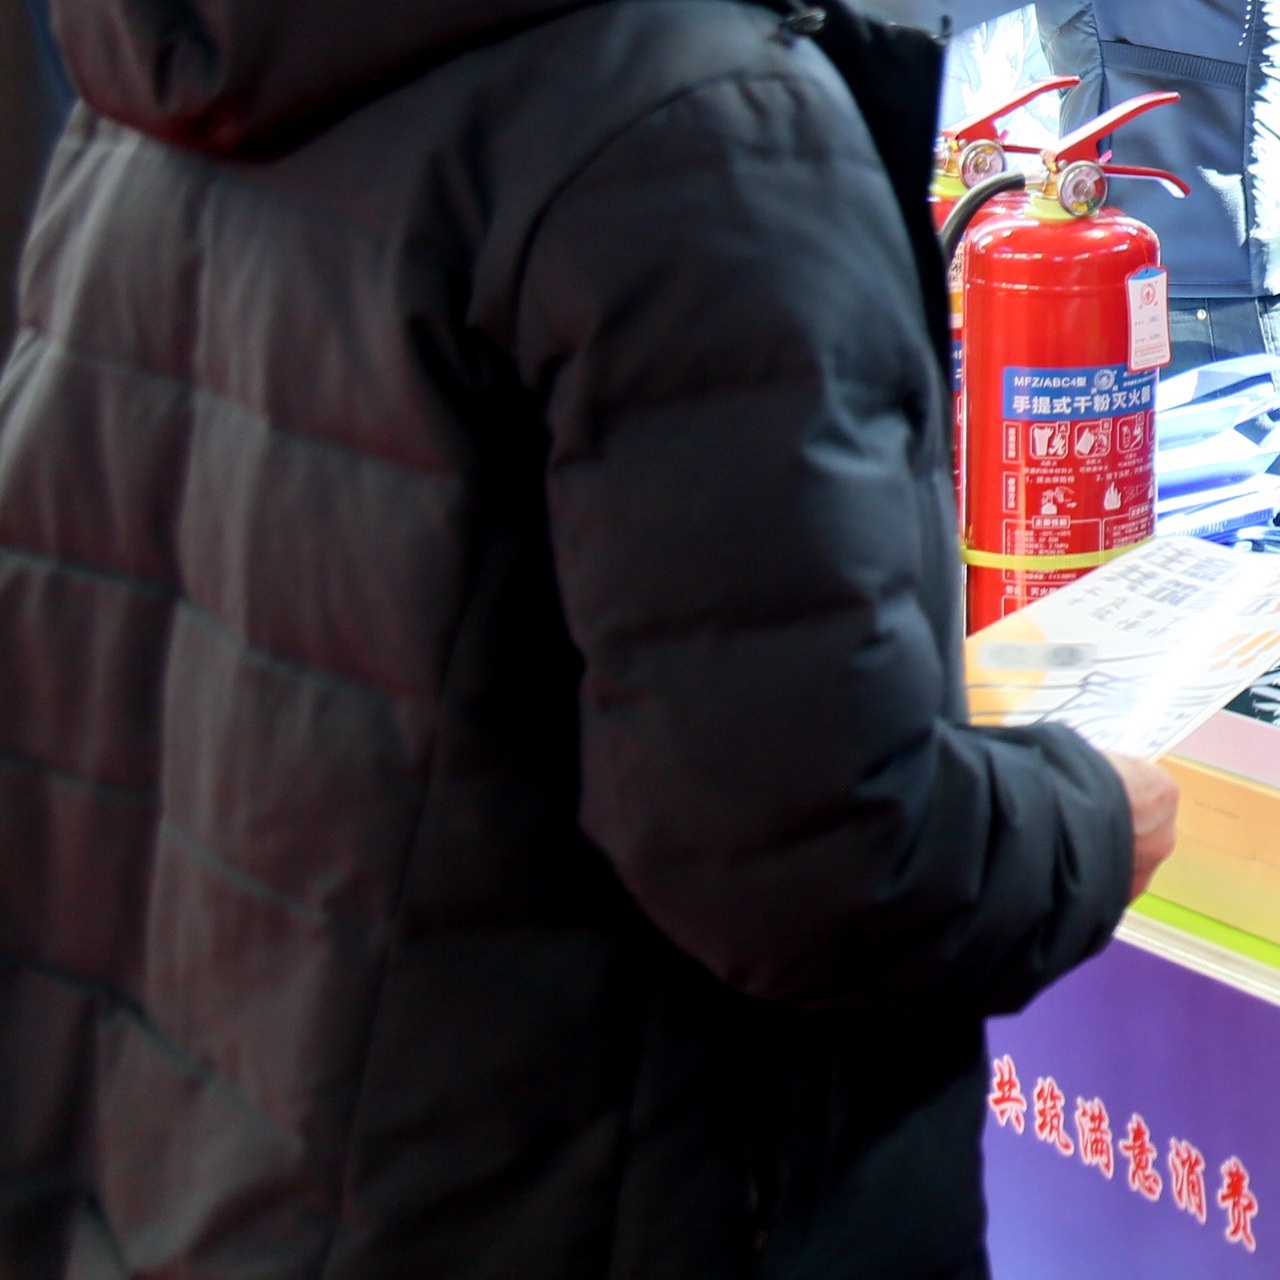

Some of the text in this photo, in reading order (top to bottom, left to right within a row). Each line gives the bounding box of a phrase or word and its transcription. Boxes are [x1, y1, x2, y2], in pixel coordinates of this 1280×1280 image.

[1013, 375, 1087, 388] MFZ/ABC4型
[1012, 385, 1151, 415] 手提式干粉灭火器
[987, 1053, 1260, 1254] 共筑满意消费
